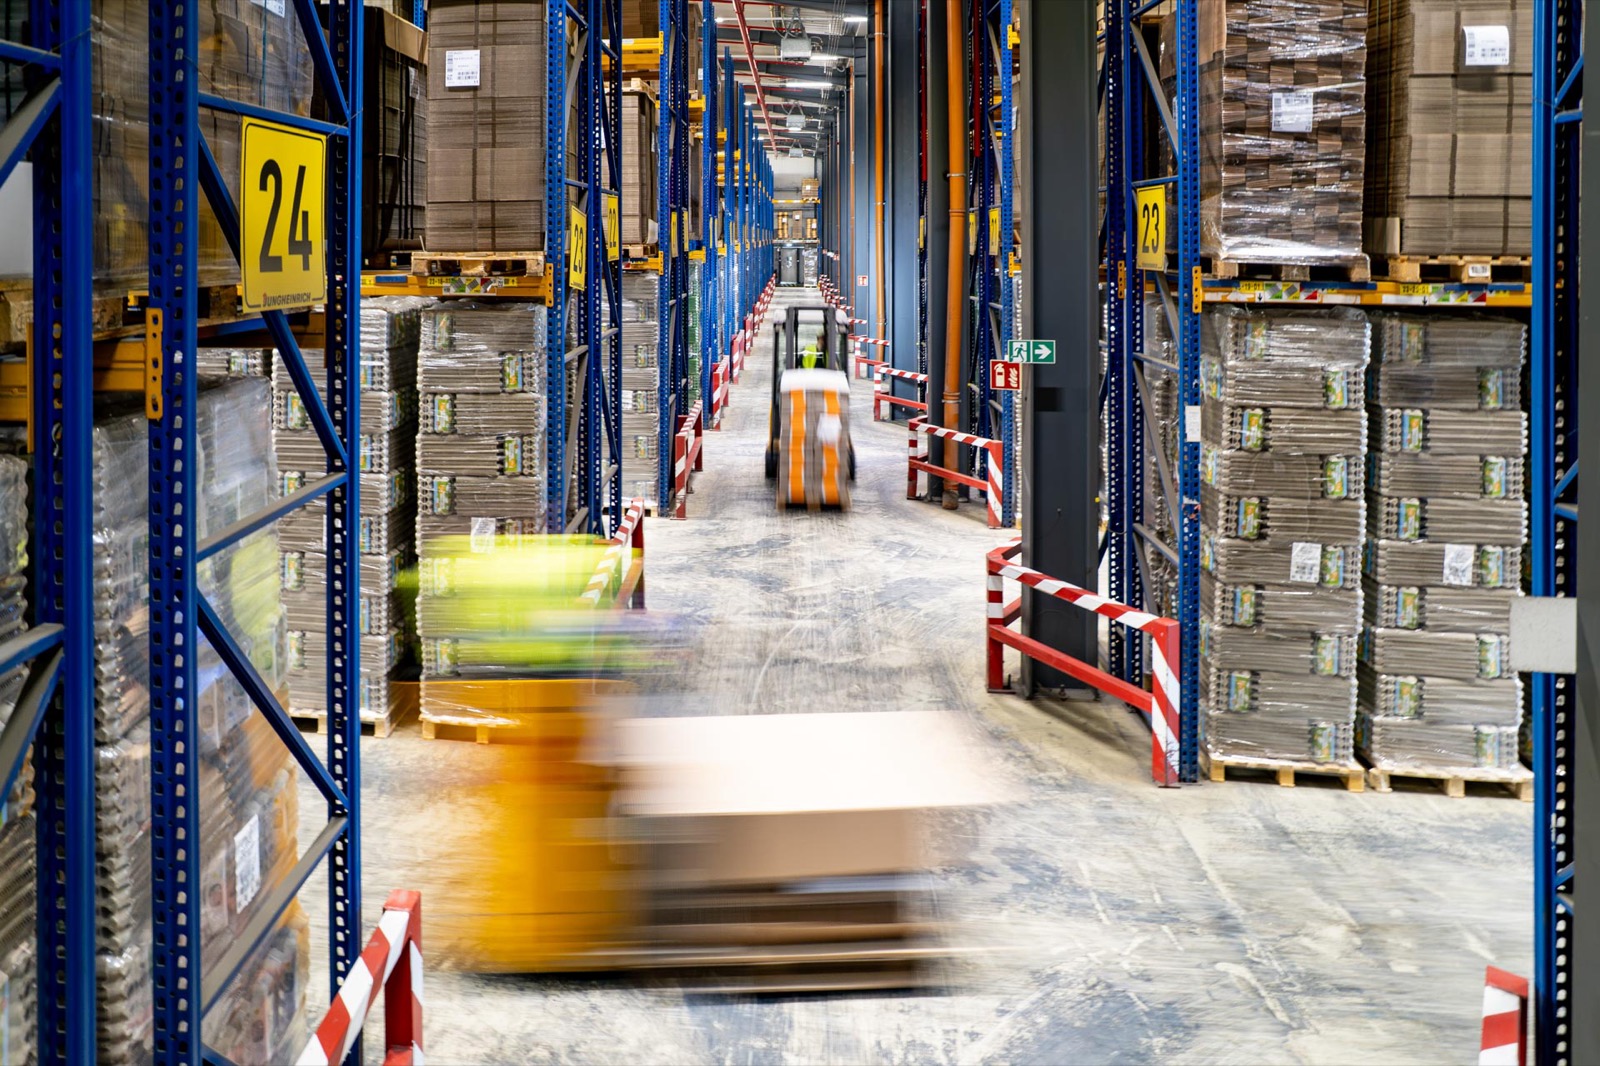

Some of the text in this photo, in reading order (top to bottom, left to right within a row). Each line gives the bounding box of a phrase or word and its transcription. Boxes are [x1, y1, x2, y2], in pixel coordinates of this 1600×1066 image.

[259, 158, 313, 273] 24
[608, 207, 617, 248] 22
[1142, 202, 1159, 254] 23
[573, 223, 584, 275] 23
[262, 292, 311, 307] JUNGHEINRICH
